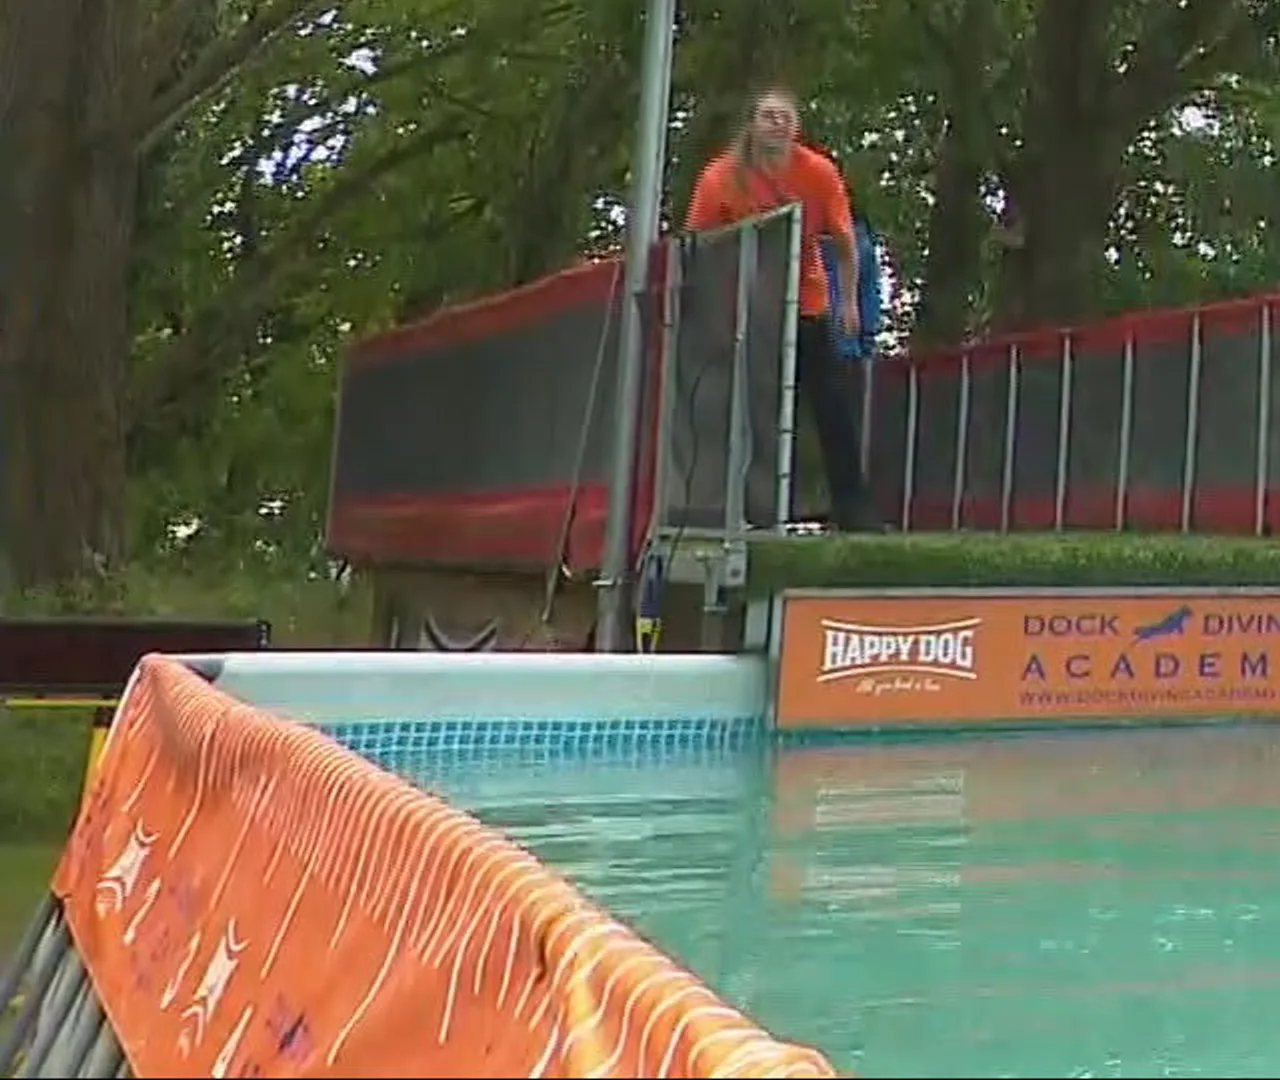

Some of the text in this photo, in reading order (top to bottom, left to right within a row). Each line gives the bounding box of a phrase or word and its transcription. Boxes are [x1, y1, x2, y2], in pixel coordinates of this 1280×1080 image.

[1023, 614, 1121, 636] DOCK
[822, 629, 975, 671] HAPPY DOG
